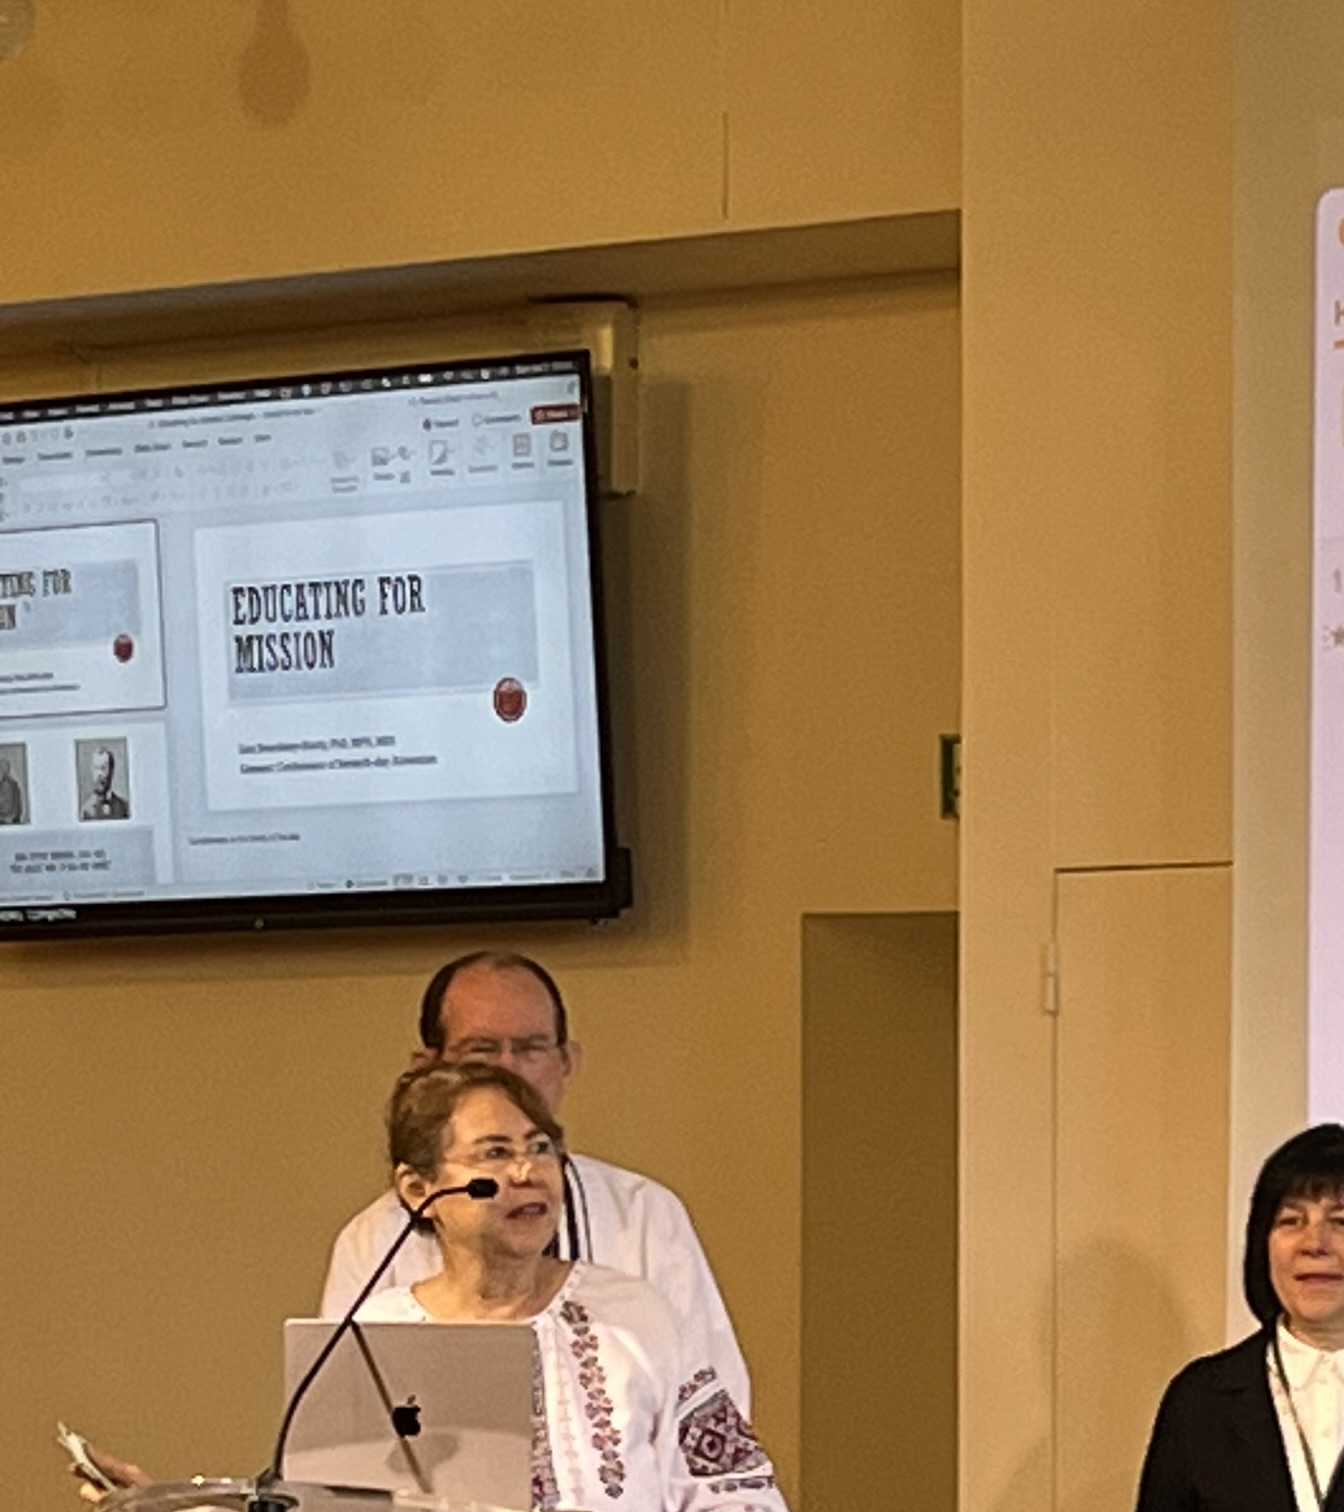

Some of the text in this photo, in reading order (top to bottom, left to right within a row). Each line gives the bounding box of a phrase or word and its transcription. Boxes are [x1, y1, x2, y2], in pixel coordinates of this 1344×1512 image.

[232, 573, 426, 627] EDUCATING FOR
[234, 629, 336, 675] MISSION
